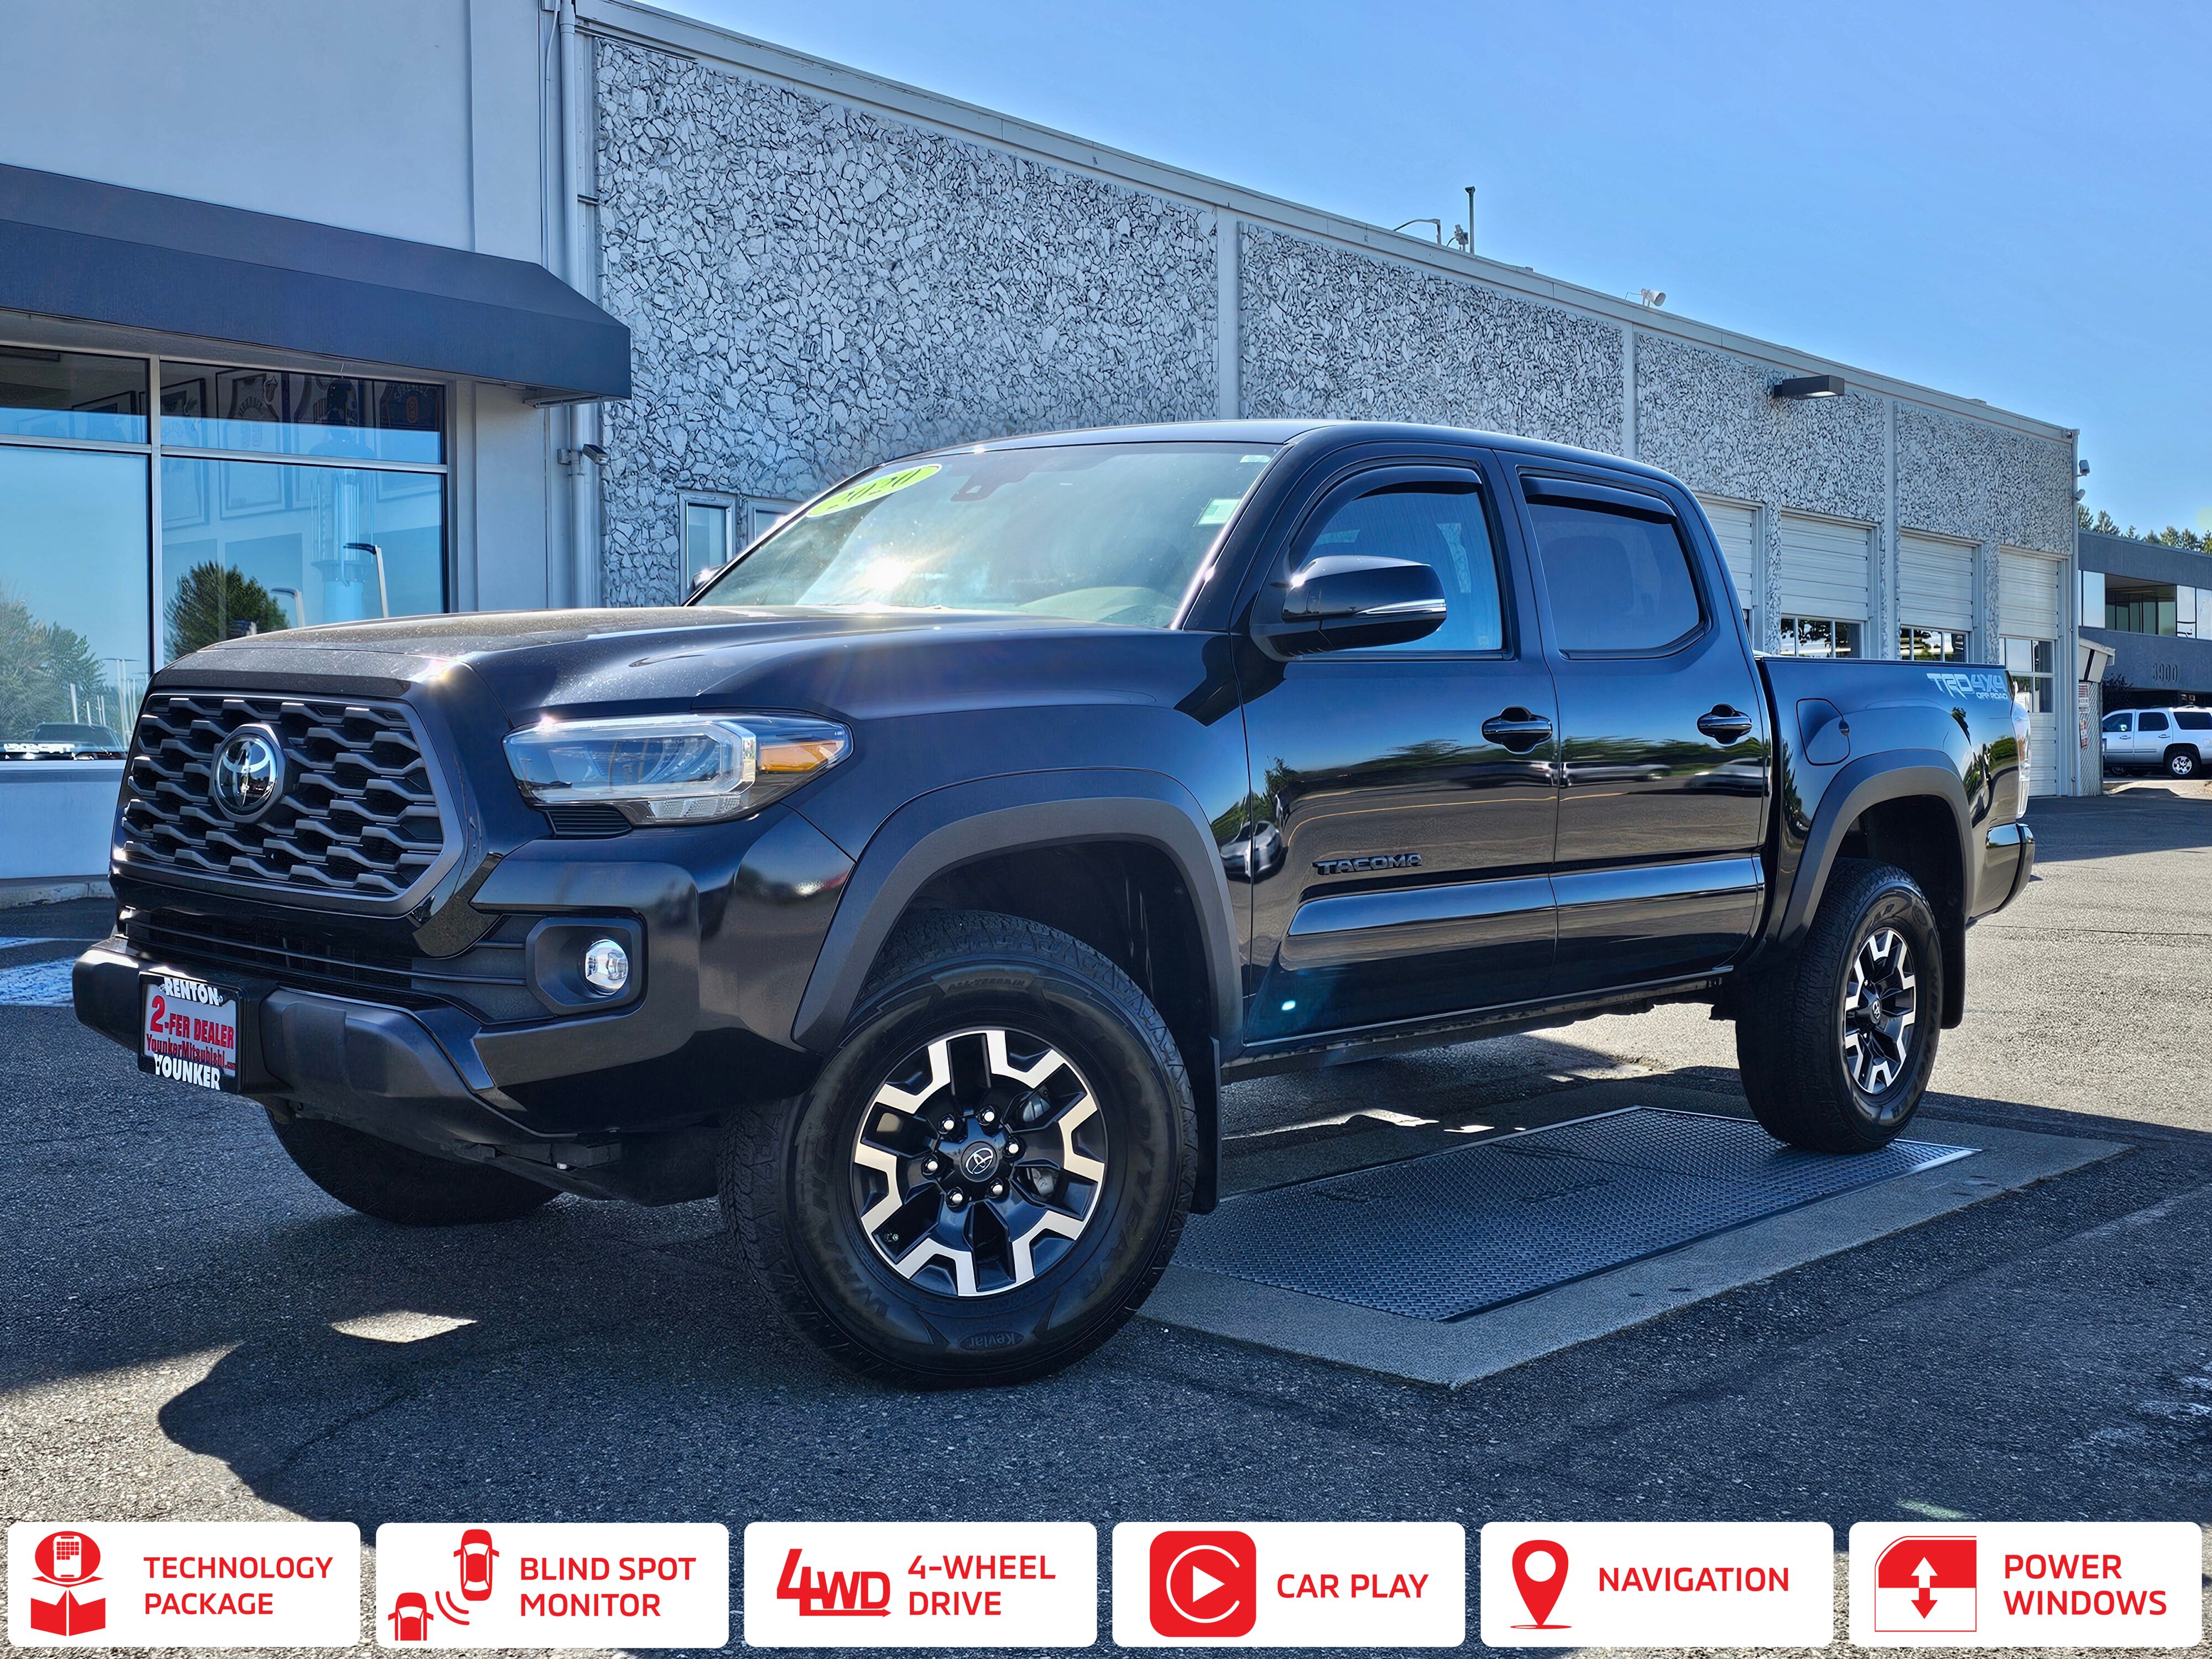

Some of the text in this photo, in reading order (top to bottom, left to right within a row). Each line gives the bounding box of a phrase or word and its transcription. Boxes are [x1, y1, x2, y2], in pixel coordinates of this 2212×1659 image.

[1927, 673, 1975, 700] TRD
[2153, 663, 2178, 683] 3900
[1312, 854, 1423, 875] TACOMA
[164, 977, 220, 1006] RENTON
[150, 995, 234, 1050] 2-FER DEALER
[153, 1053, 220, 1090] YOUNKER
